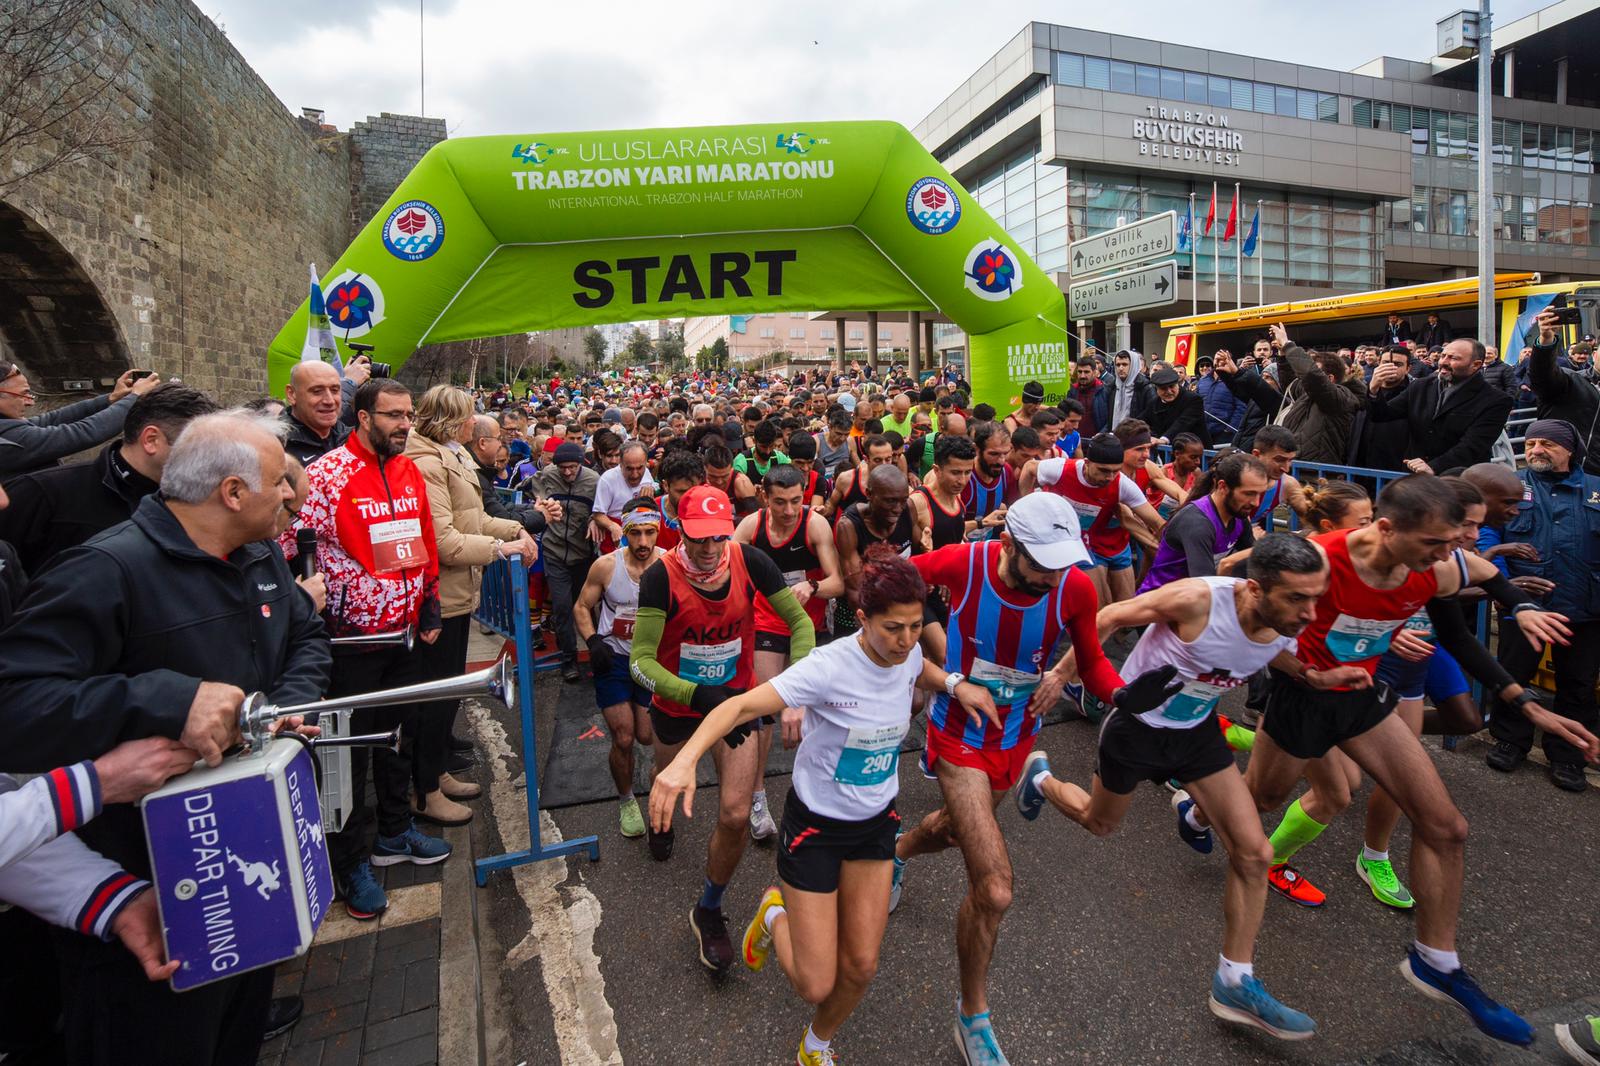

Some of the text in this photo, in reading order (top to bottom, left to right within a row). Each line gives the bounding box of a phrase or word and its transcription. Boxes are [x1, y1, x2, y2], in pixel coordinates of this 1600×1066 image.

[1147, 105, 1228, 128] TRABZON
[1133, 119, 1243, 152] BÜYÜKŞEHİR
[579, 136, 767, 162] ULUSLARARASI
[1140, 142, 1239, 167] BELEDİYESİ
[511, 160, 834, 190] TRABZON YARI MARATONU
[548, 188, 803, 209] INTERNATIONAL TRABZON HALF MARATHON
[1104, 229, 1142, 248] Valilik
[1084, 235, 1168, 269] (Governorate)
[572, 250, 797, 309] START
[1075, 275, 1146, 300] Devlet Sahil
[1075, 301, 1098, 312] Yolu
[358, 496, 418, 519] TÜRKİYE
[396, 542, 412, 559] 61
[1354, 638, 1369, 653] 6
[698, 664, 725, 678] 260
[861, 752, 893, 774] 290
[288, 771, 320, 922] DEPAR TIMING
[184, 793, 239, 972] DEPAR TIMING
